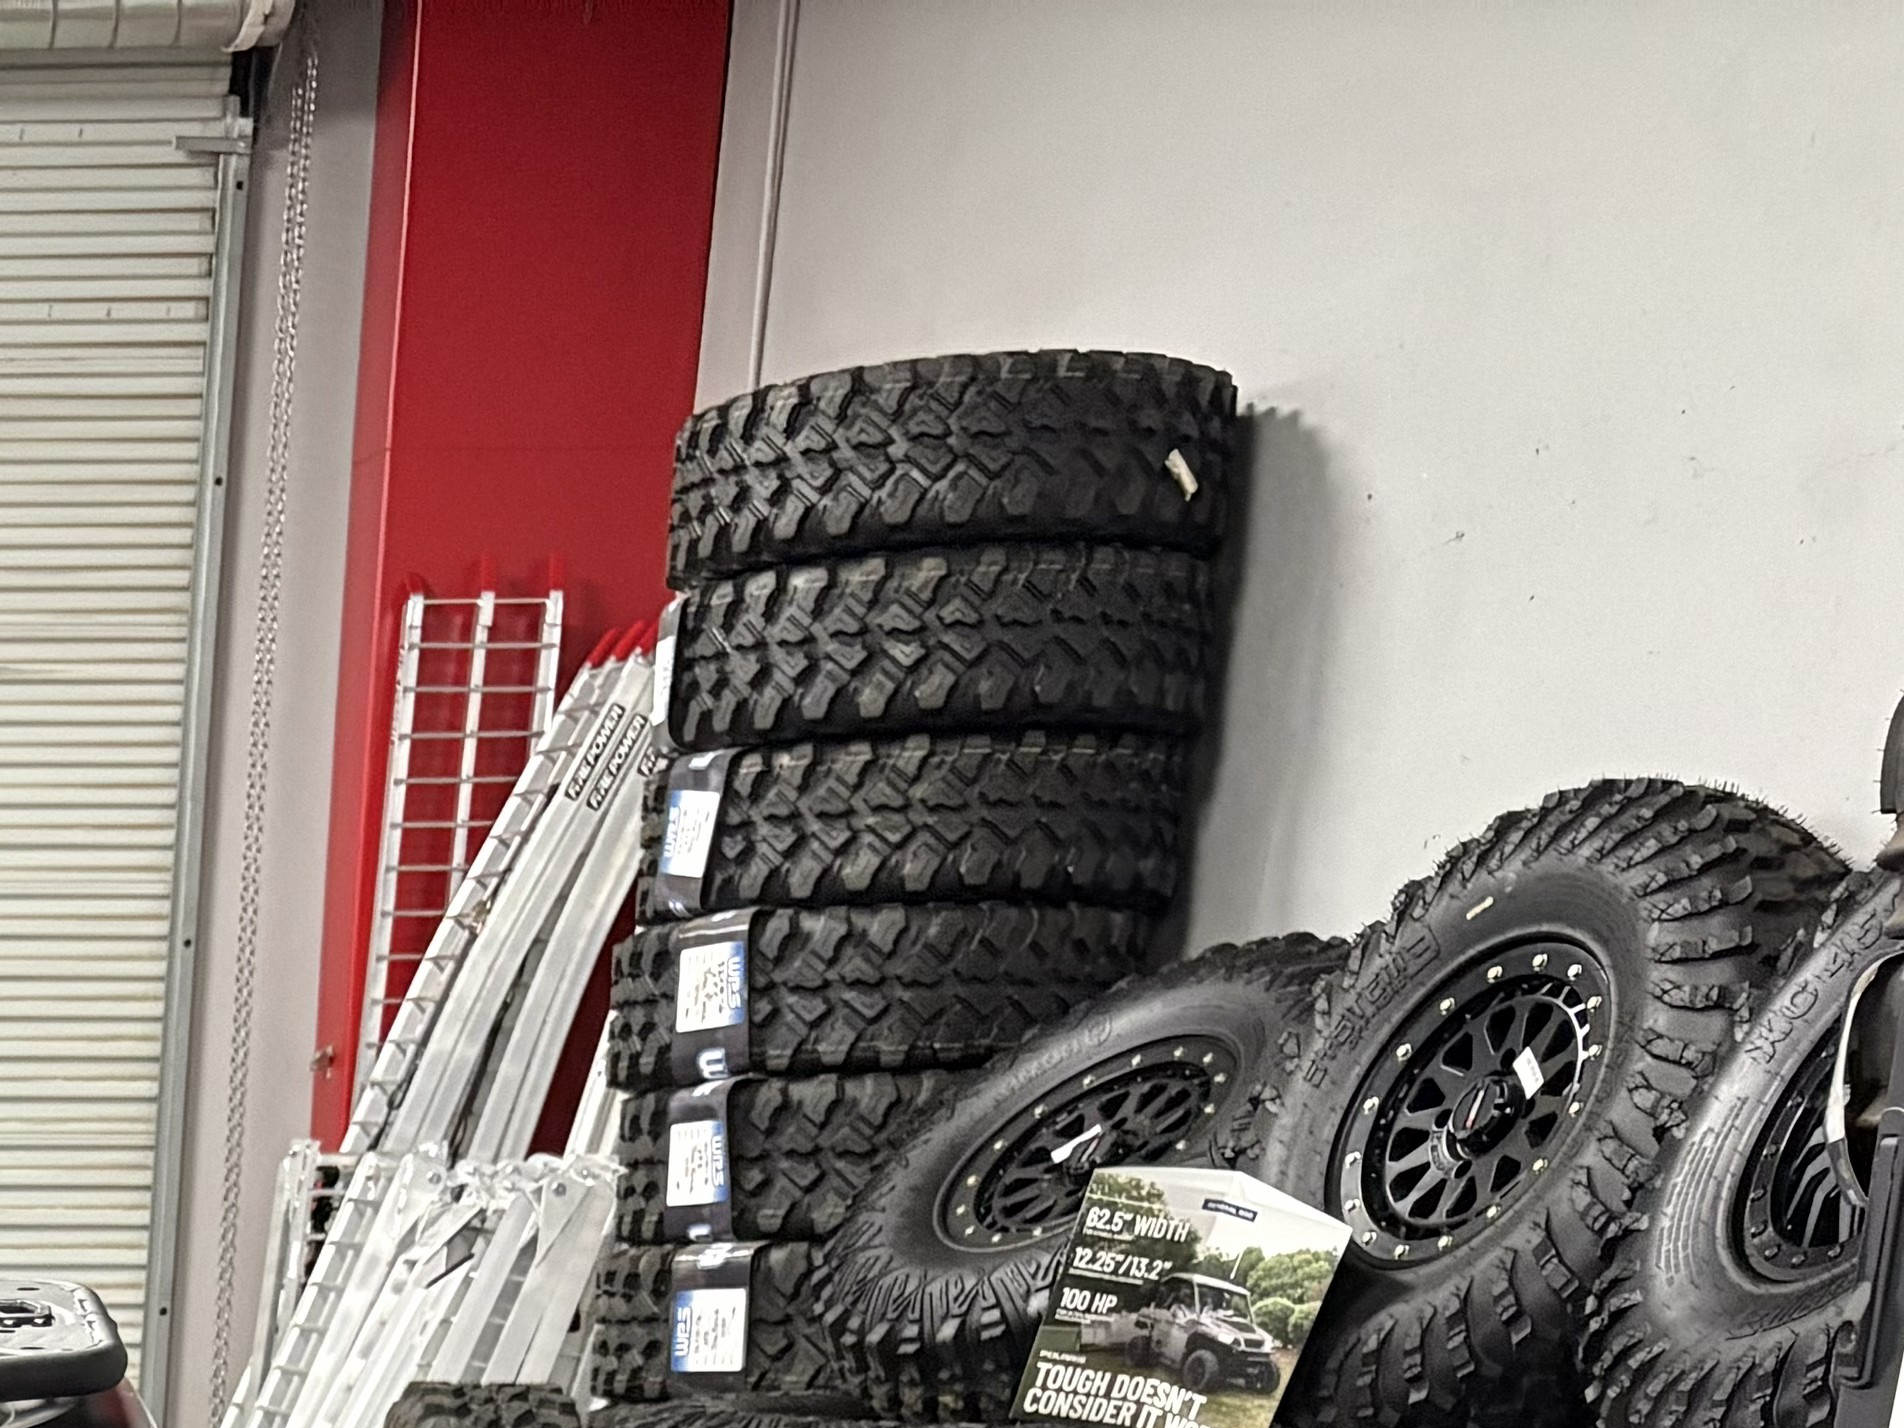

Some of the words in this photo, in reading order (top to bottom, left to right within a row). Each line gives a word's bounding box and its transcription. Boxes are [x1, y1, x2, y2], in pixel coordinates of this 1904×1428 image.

[587, 704, 623, 766] POWER
[609, 714, 646, 775] POWER
[727, 955, 742, 1010] WPS
[711, 1134, 725, 1187] WPS
[1134, 1213, 1191, 1243] WIDTH
[1060, 1286, 1091, 1311] 100
[1092, 1292, 1118, 1315] HP
[675, 1306, 692, 1357] WPS
[1023, 1388, 1138, 1428] CONSIDER
[1035, 1361, 1112, 1398] TOUGH
[1110, 1373, 1208, 1421] DOESN'T
